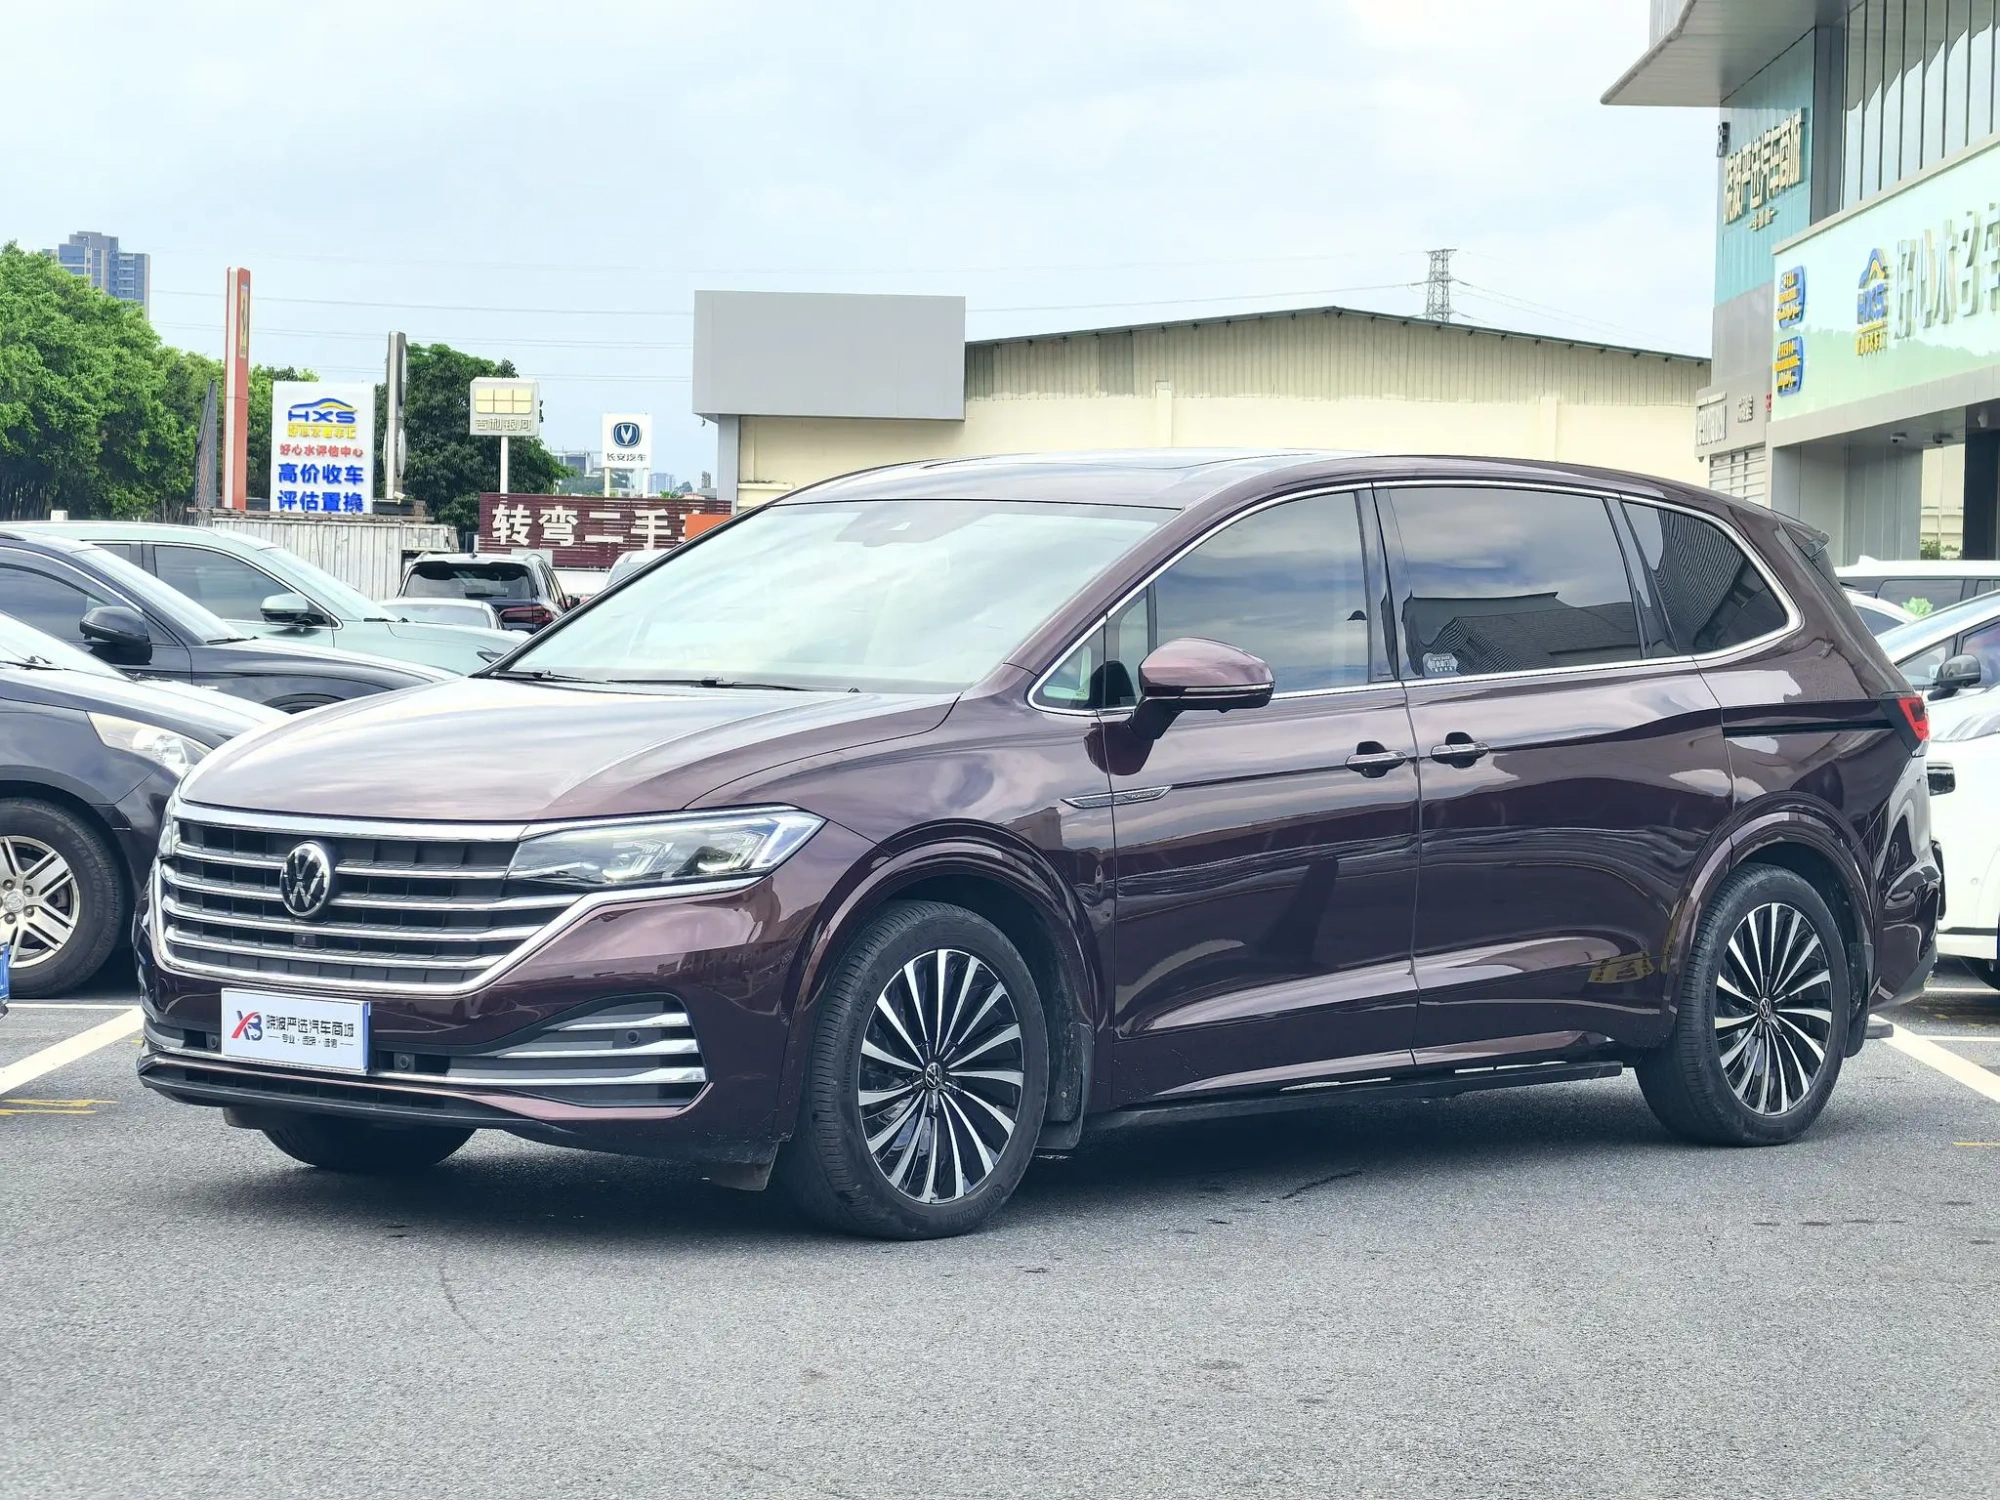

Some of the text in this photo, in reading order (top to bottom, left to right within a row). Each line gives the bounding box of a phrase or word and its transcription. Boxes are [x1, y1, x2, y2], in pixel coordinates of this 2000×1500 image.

[288, 410, 356, 424] HXS
[475, 418, 532, 432] 吉利银河
[280, 443, 364, 458] 好心水评估中心
[606, 452, 647, 462] 长安汽车
[278, 463, 364, 486] 高价收车
[277, 490, 364, 513] 评估置换
[491, 504, 703, 551] 转弯二手
